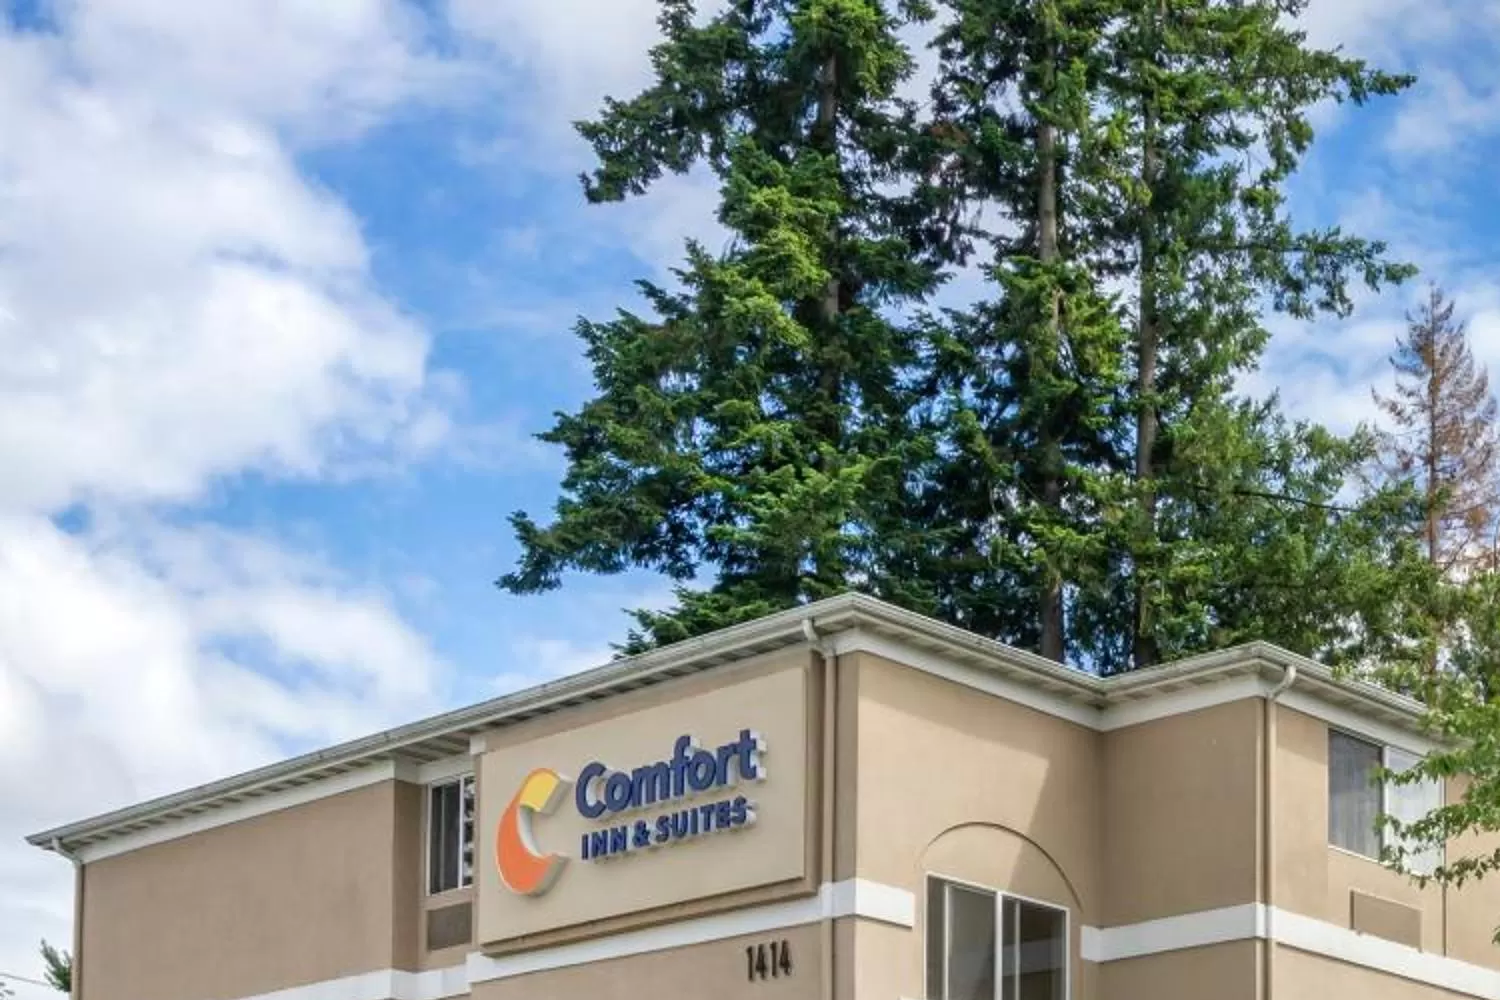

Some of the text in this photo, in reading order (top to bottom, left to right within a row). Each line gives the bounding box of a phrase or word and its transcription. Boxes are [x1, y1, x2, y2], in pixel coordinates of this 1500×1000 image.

[575, 728, 758, 819] Comfort
[581, 796, 748, 861] INN & SUITES
[746, 939, 791, 983] 1414
